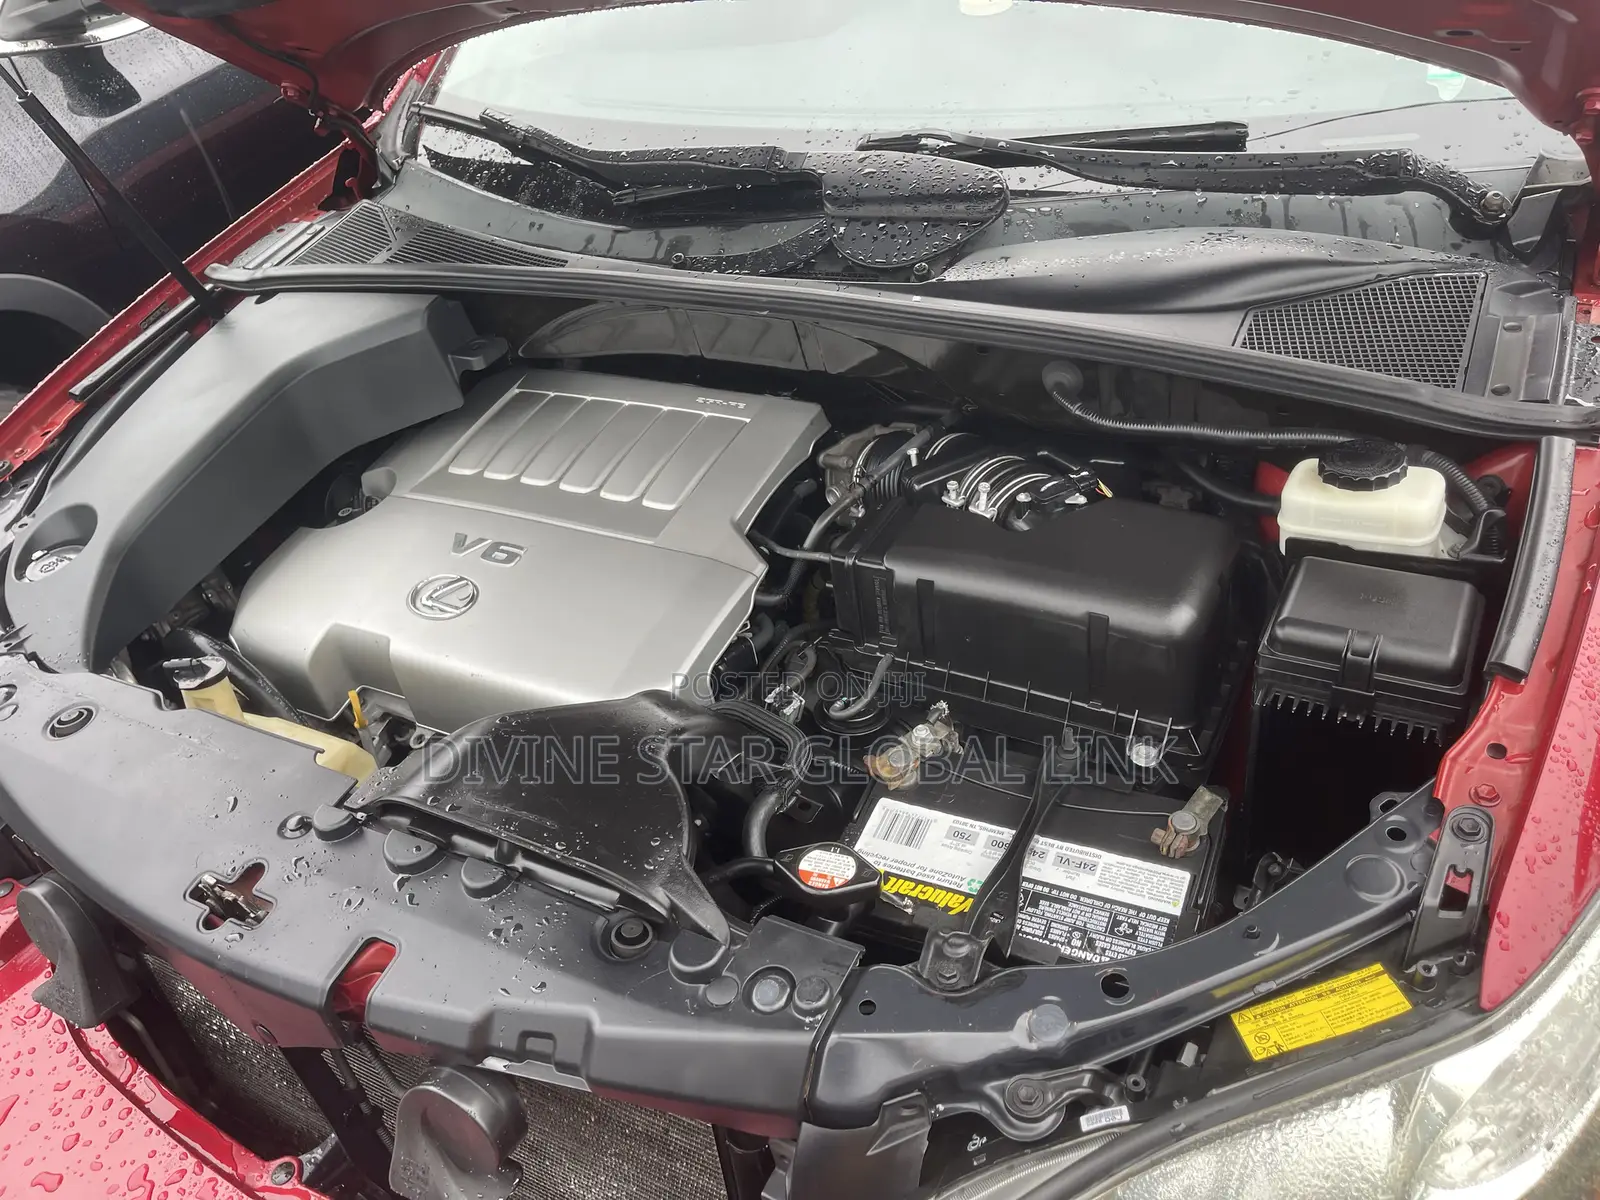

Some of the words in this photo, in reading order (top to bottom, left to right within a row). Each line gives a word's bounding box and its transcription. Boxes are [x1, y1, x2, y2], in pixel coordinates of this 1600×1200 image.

[451, 532, 528, 567] V6
[952, 829, 971, 841] 750
[977, 825, 1004, 836] MEMPHIS,
[990, 838, 1009, 850] 600
[856, 847, 889, 862] recycling
[1064, 845, 1101, 859] DISTRIBUTED
[890, 856, 918, 869] proper
[1055, 854, 1096, 872] 24F-VL
[882, 862, 915, 876] batteries
[928, 867, 966, 881] AutoZone
[916, 871, 935, 881] used
[937, 876, 963, 888] Return
[883, 875, 974, 914] Valucraft
[1156, 916, 1170, 924] KEEP
[1047, 933, 1065, 942] SPARKS
[1049, 927, 1067, 936] FLAMES
[1070, 938, 1082, 947] NO
[1262, 1005, 1285, 1017] CAUTION
[1288, 994, 1317, 1008] ATTENTION
